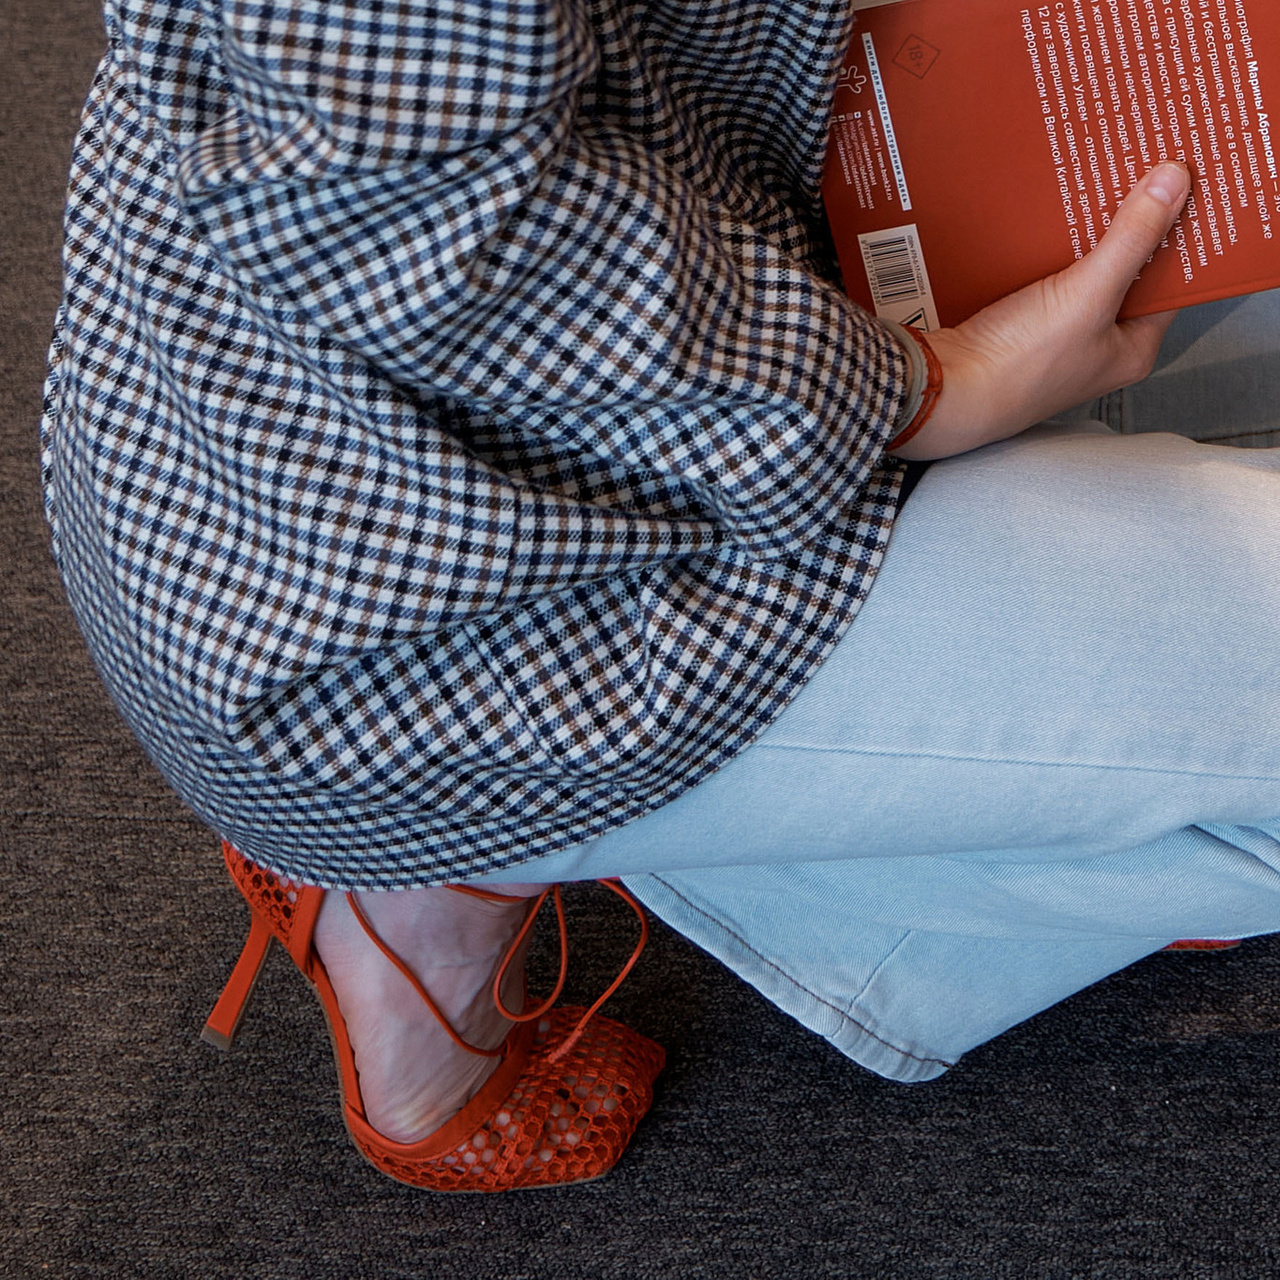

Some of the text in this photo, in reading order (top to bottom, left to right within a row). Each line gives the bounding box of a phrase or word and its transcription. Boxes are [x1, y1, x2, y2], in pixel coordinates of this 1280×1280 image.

[1037, 5, 1050, 18] 12
[1041, 21, 1053, 39] лет
[1020, 9, 1047, 98] перформансом
[1080, 34, 1101, 99] посвящена
[1165, 16, 1185, 75] присущим
[1203, 21, 1226, 101] бесстрашием,
[1045, 42, 1069, 120] завершились
[1091, 5, 1112, 64] желанием
[1104, 66, 1121, 112] познать
[1114, 114, 1132, 154] людей.
[1155, 52, 1171, 97] юности,
[1178, 77, 1191, 92] ей
[1225, 42, 1249, 130] высказывание,
[864, 39, 875, 66] книги
[876, 88, 888, 120] любого
[883, 123, 901, 175] настроения
[1040, 99, 1051, 114] на
[1055, 11, 1079, 83] художником
[1072, 83, 1088, 121] Улаем
[1084, 136, 1107, 210] отношениям,
[1094, 101, 1105, 115] ее
[1124, 71, 1151, 163] неисчерпаемым
[1165, 99, 1183, 147] которые
[1180, 94, 1197, 127] сухим
[1219, 103, 1231, 123] как
[1224, 125, 1234, 139] ее
[1246, 60, 1264, 110] Марины
[1256, 112, 1278, 179] Абрамович
[1044, 115, 1064, 165] Великой
[1063, 121, 1086, 191] совместным
[1098, 117, 1121, 188] отношениям
[1137, 53, 1163, 131] авторитарной
[1175, 226, 1193, 283] искусстве,
[1189, 129, 1206, 176] юмором
[1192, 65, 1221, 160] художественные
[1214, 162, 1238, 245] перформансы.
[1241, 132, 1262, 187] дышащее
[1055, 166, 1077, 225] Китайской
[1187, 196, 1198, 218] под
[1229, 151, 1248, 207] основном
[1255, 189, 1271, 221] такой
[1190, 219, 1208, 266] жестким
[1197, 178, 1223, 255] рассказывает
[1262, 223, 1272, 239] же
